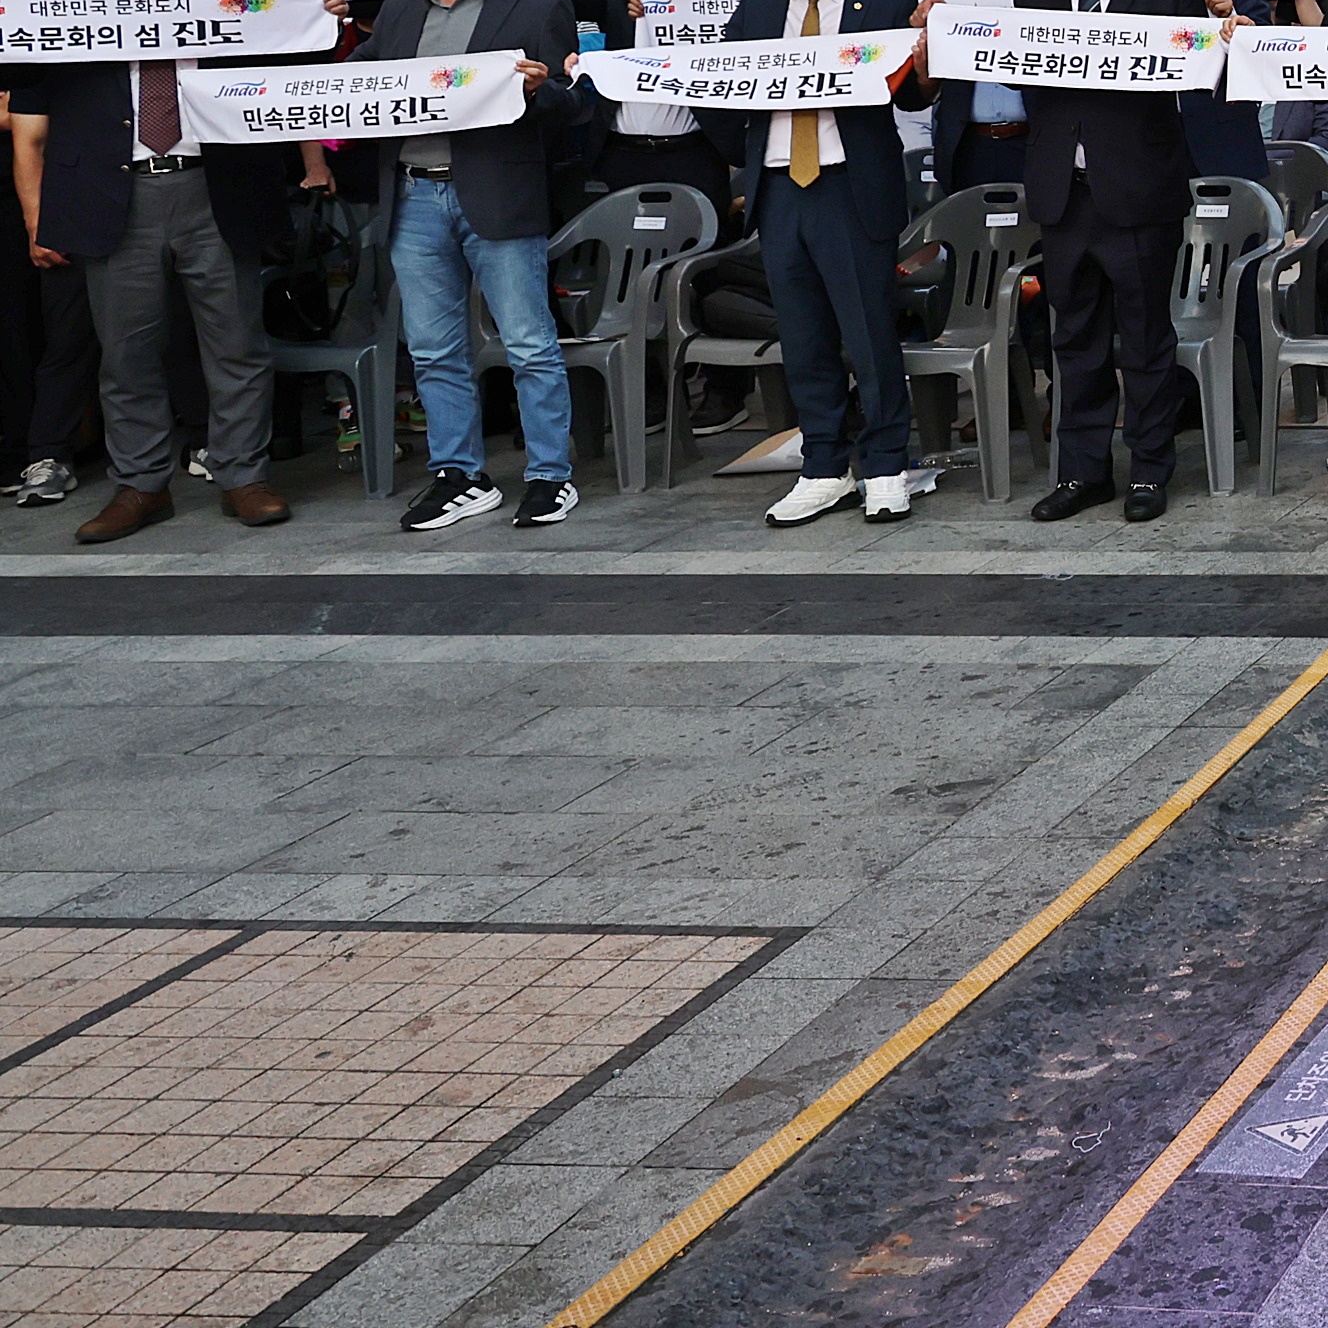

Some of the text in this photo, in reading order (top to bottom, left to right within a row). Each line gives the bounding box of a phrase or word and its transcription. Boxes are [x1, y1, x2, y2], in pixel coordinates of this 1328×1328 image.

[30, 0, 108, 18] 대한민국
[135, 18, 245, 48] 섬 진도
[947, 19, 1000, 38] Jindo
[1019, 26, 1148, 48] 대한민국 문화도시
[1251, 35, 1305, 54] Jindo
[690, 51, 817, 72] 대한민국 문화도시
[973, 48, 1187, 81] 민속문화의 섬 진도
[284, 75, 409, 97] 대한민국 문화도시
[636, 71, 853, 99] 민속문화의 섬 진도
[243, 94, 449, 132] 민속문화의 섬 진도
